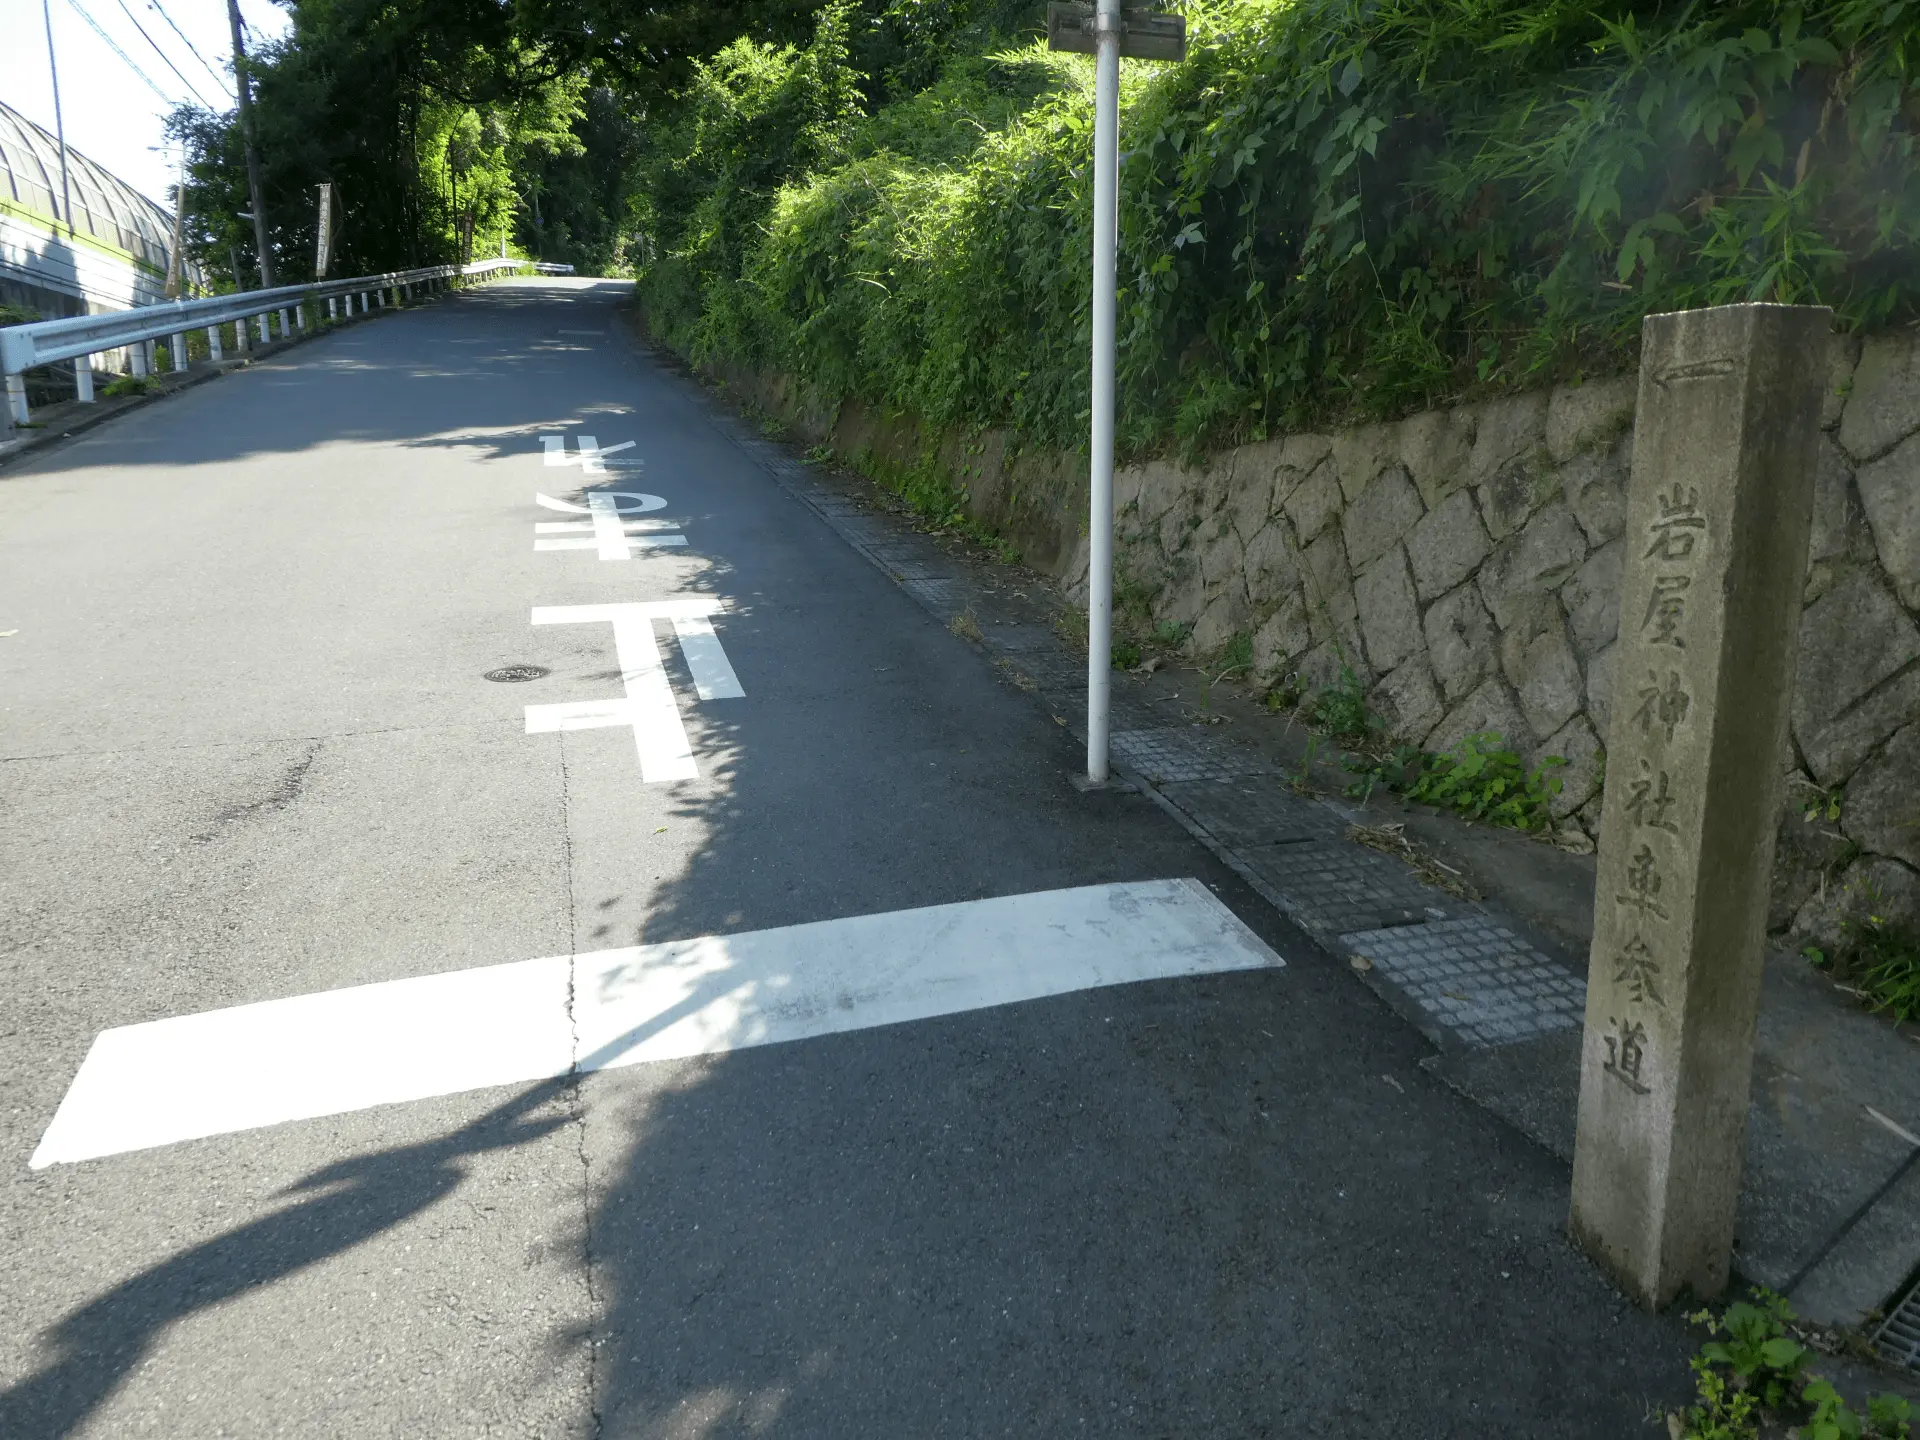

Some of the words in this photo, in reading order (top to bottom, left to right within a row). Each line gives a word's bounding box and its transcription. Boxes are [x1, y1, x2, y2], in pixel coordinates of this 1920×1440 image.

[524, 435, 746, 783] 止まれ
[1602, 484, 1706, 1096] 岩屋神社車参道
